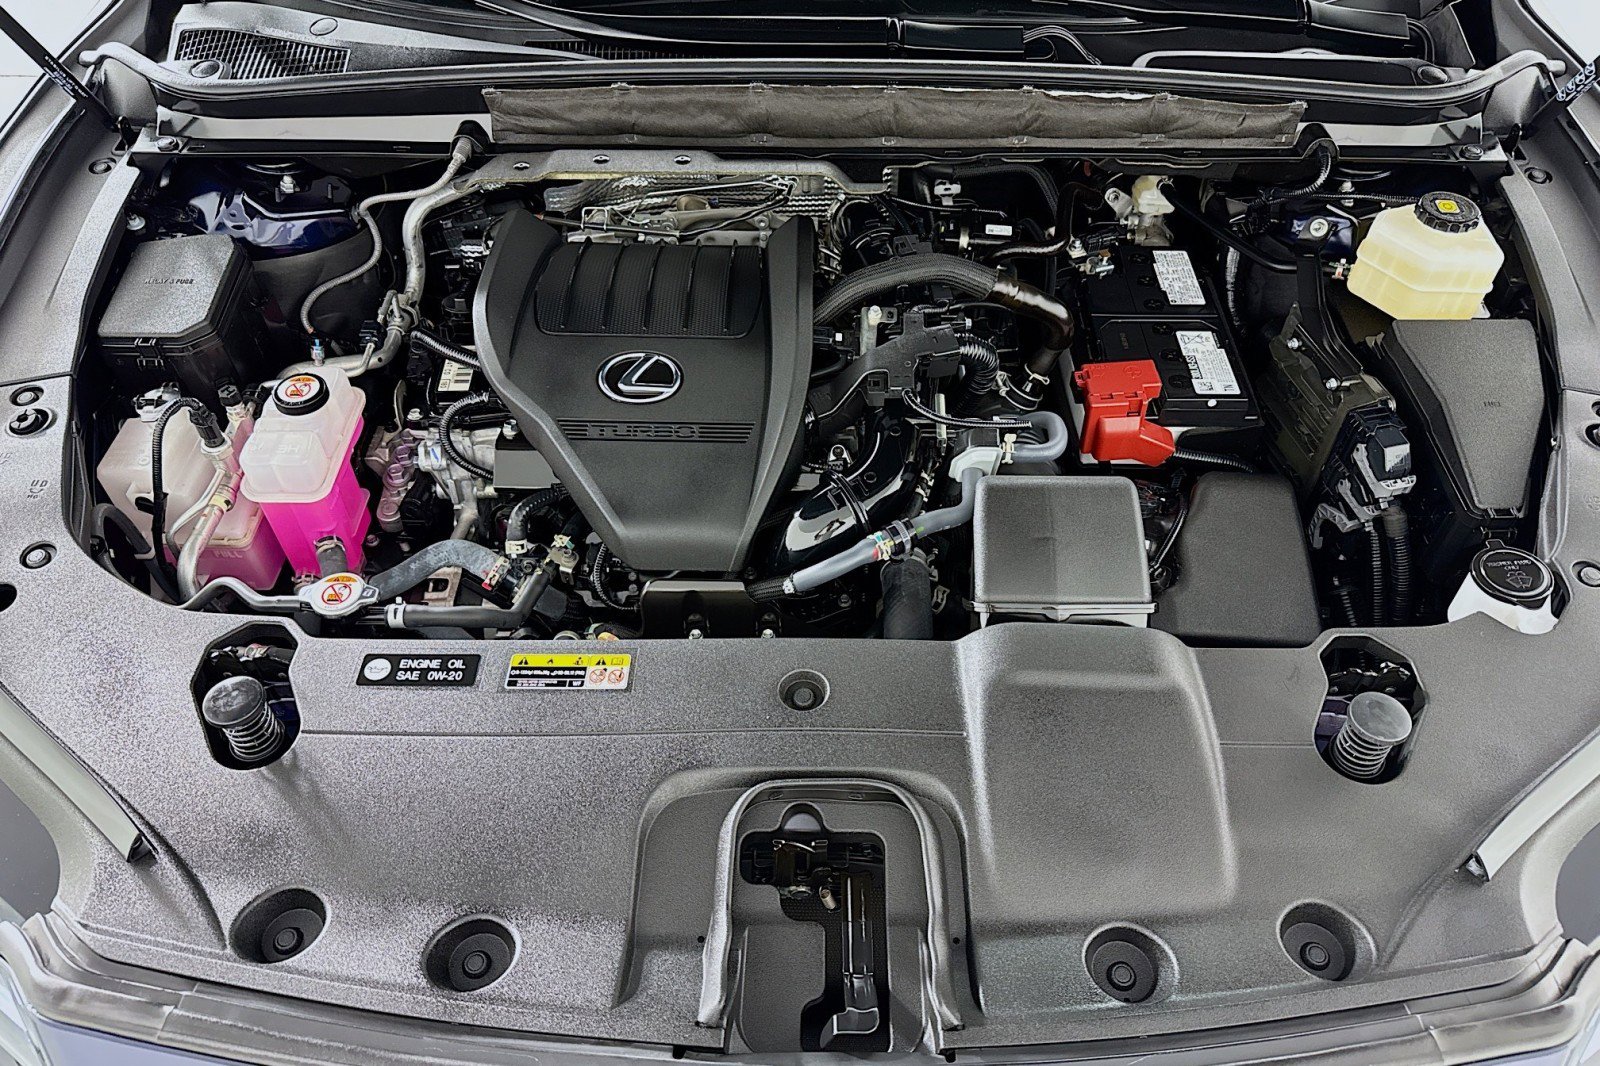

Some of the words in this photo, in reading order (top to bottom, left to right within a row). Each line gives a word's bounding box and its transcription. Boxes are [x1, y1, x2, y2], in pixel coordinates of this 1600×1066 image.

[586, 423, 698, 438] TURBO
[399, 659, 442, 669] ENGINE
[447, 659, 466, 669] OIL
[395, 670, 421, 681] SAE
[427, 670, 464, 681] 0W-20
